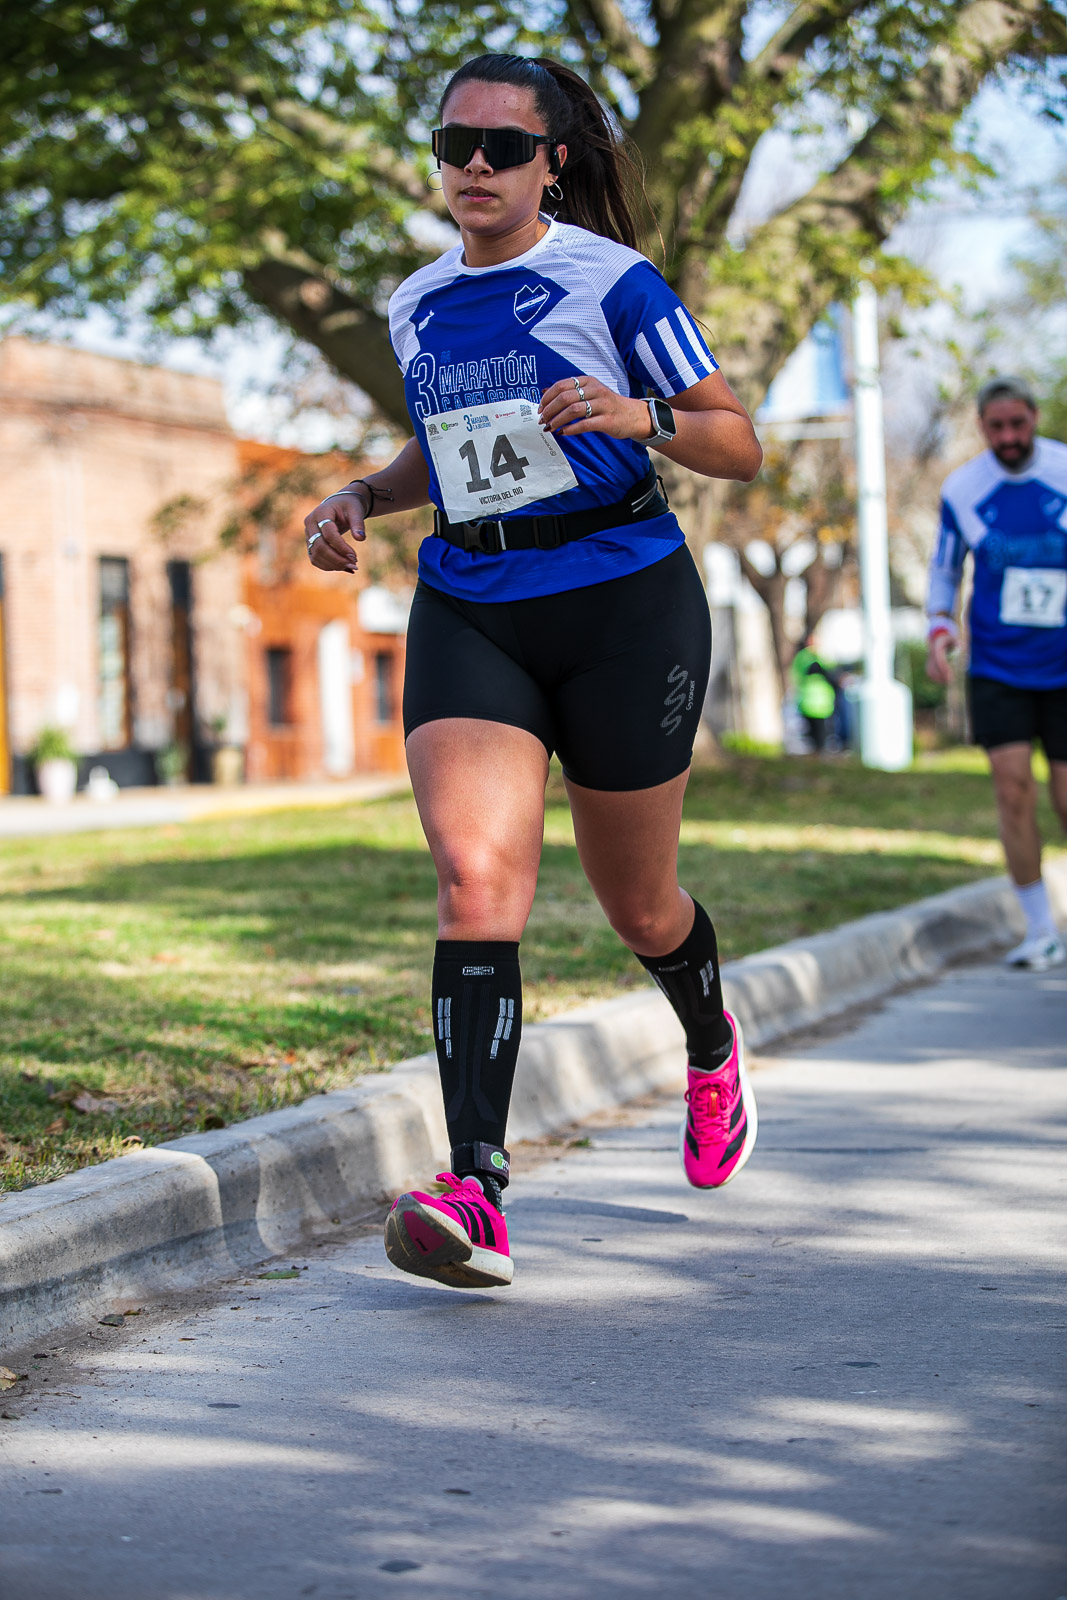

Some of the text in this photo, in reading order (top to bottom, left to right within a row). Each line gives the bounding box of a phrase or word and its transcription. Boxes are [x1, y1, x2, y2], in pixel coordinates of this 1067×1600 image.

[411, 349, 538, 425] 3 MARATÓN
[458, 434, 530, 493] 14
[479, 486, 524, 505] VICTORIA DEL RIO
